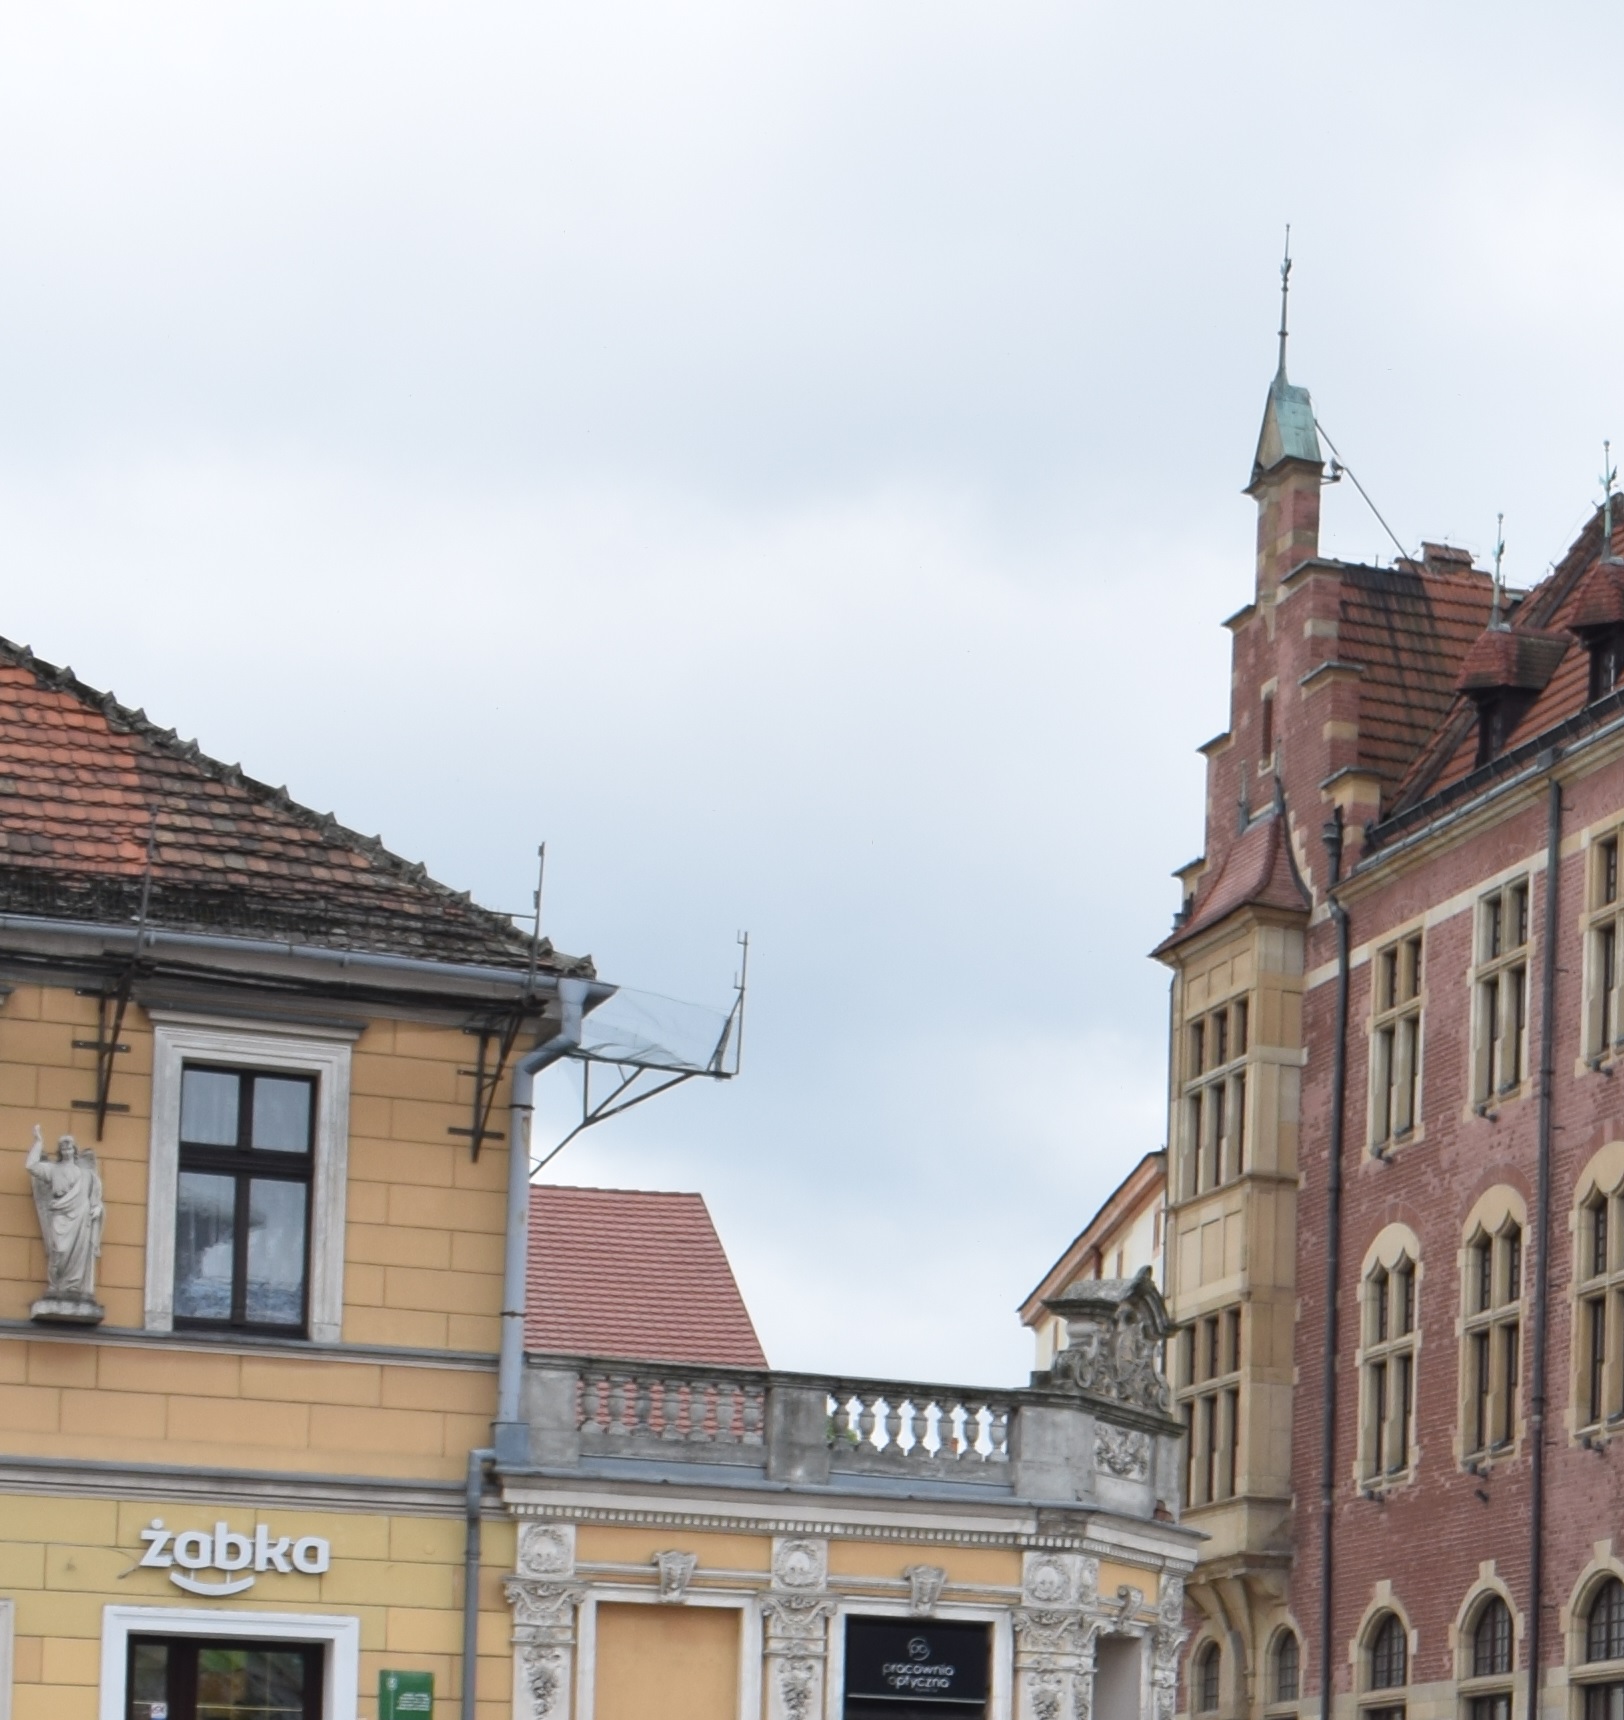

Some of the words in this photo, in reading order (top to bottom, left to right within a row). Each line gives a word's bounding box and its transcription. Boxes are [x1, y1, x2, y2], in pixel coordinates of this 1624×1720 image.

[140, 1519, 330, 1574] żabka
[882, 1662, 955, 1677] pracownia
[887, 1675, 951, 1690] optyczna
